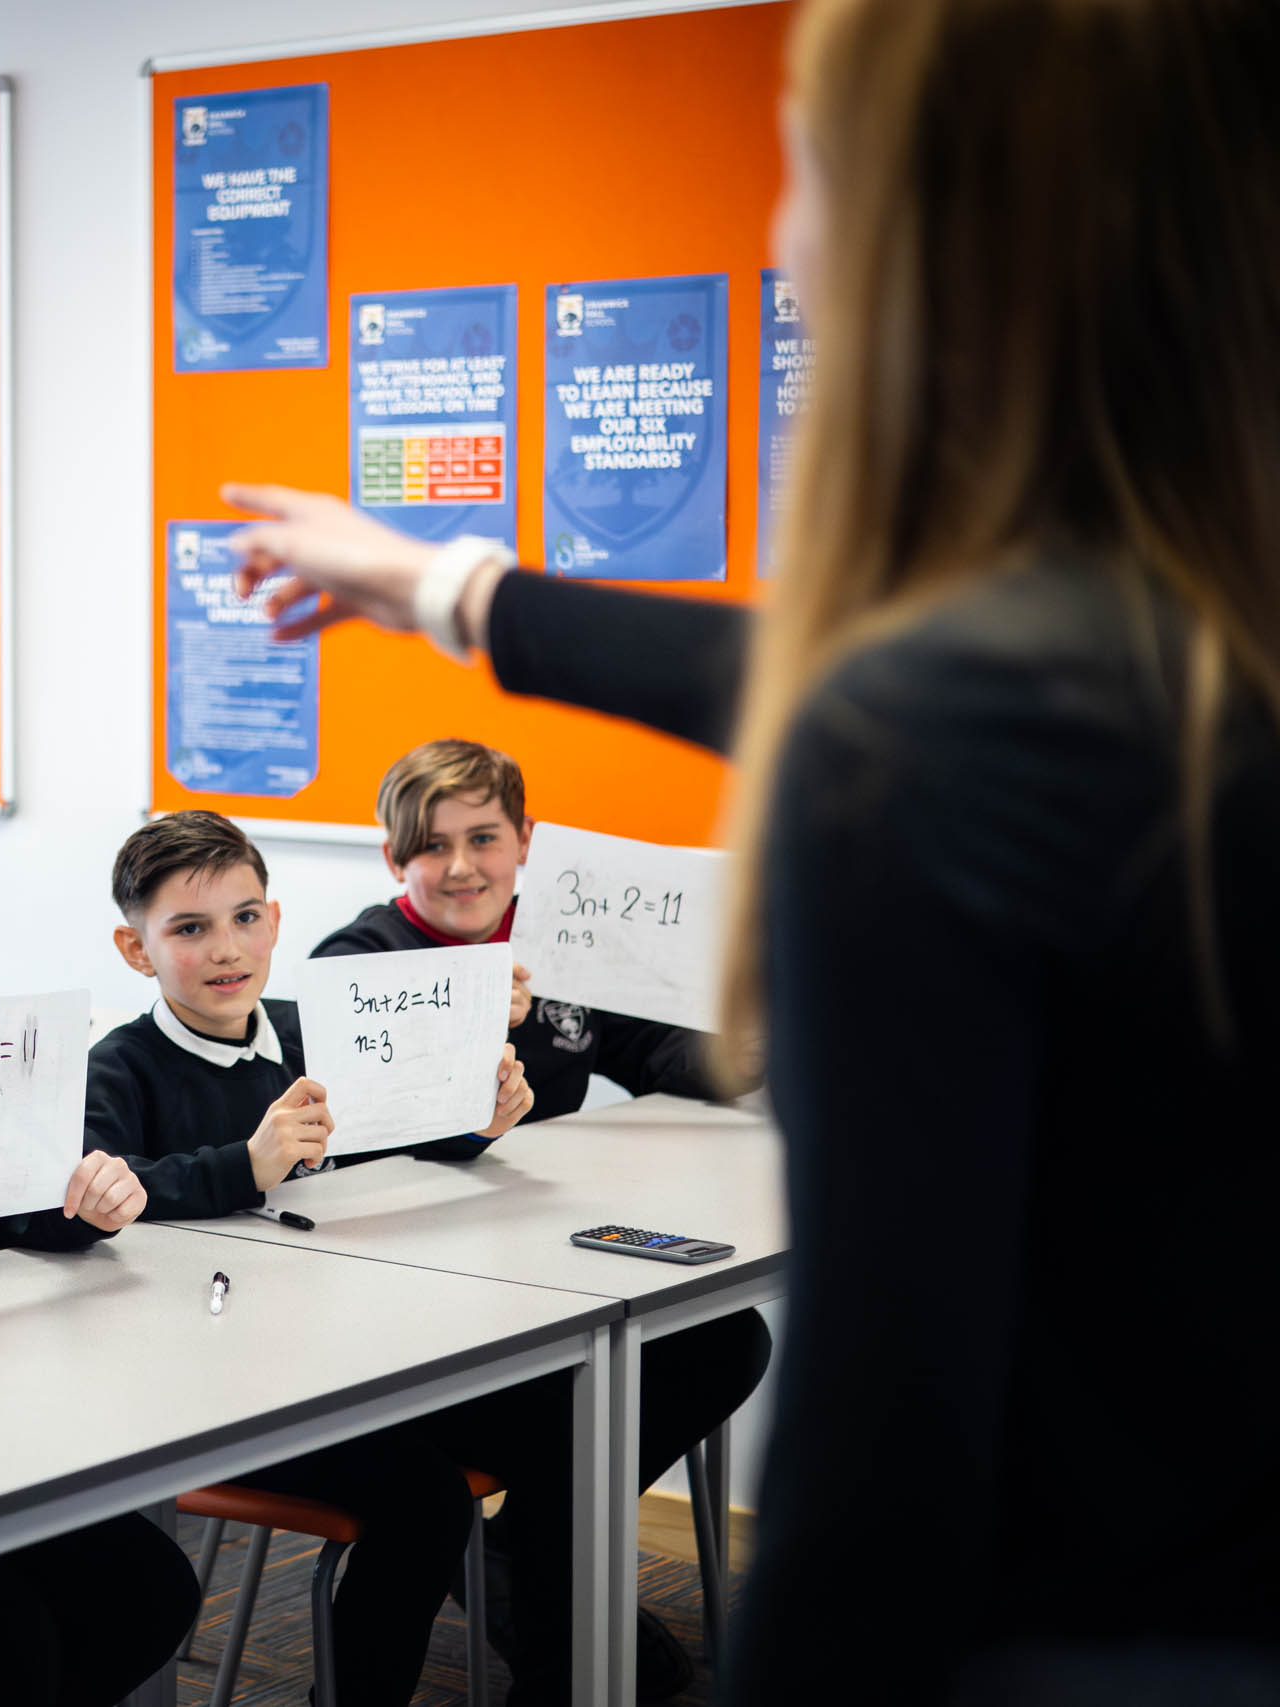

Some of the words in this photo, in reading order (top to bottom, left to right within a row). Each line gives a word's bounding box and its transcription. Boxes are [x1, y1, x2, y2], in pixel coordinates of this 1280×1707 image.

[202, 173, 225, 190] WE
[228, 169, 267, 187] HAVE
[268, 166, 297, 184] THE
[216, 185, 283, 204] CORRECT
[206, 200, 292, 222] EQUIPMENT
[775, 339, 799, 355] WE
[573, 366, 601, 384] WE
[602, 364, 636, 382] ARE
[638, 361, 696, 380] READY
[556, 384, 580, 402] TO
[582, 382, 635, 400] LEARN
[637, 379, 713, 399] BECAUSE
[564, 402, 591, 419] WE
[593, 400, 627, 418] ARE
[628, 398, 704, 416] MEETING
[776, 400, 795, 416] TO
[599, 416, 637, 435] OUR
[639, 415, 667, 434] SIX
[571, 432, 696, 453] EMPLOYABILITY
[584, 450, 682, 471] STANDARDS
